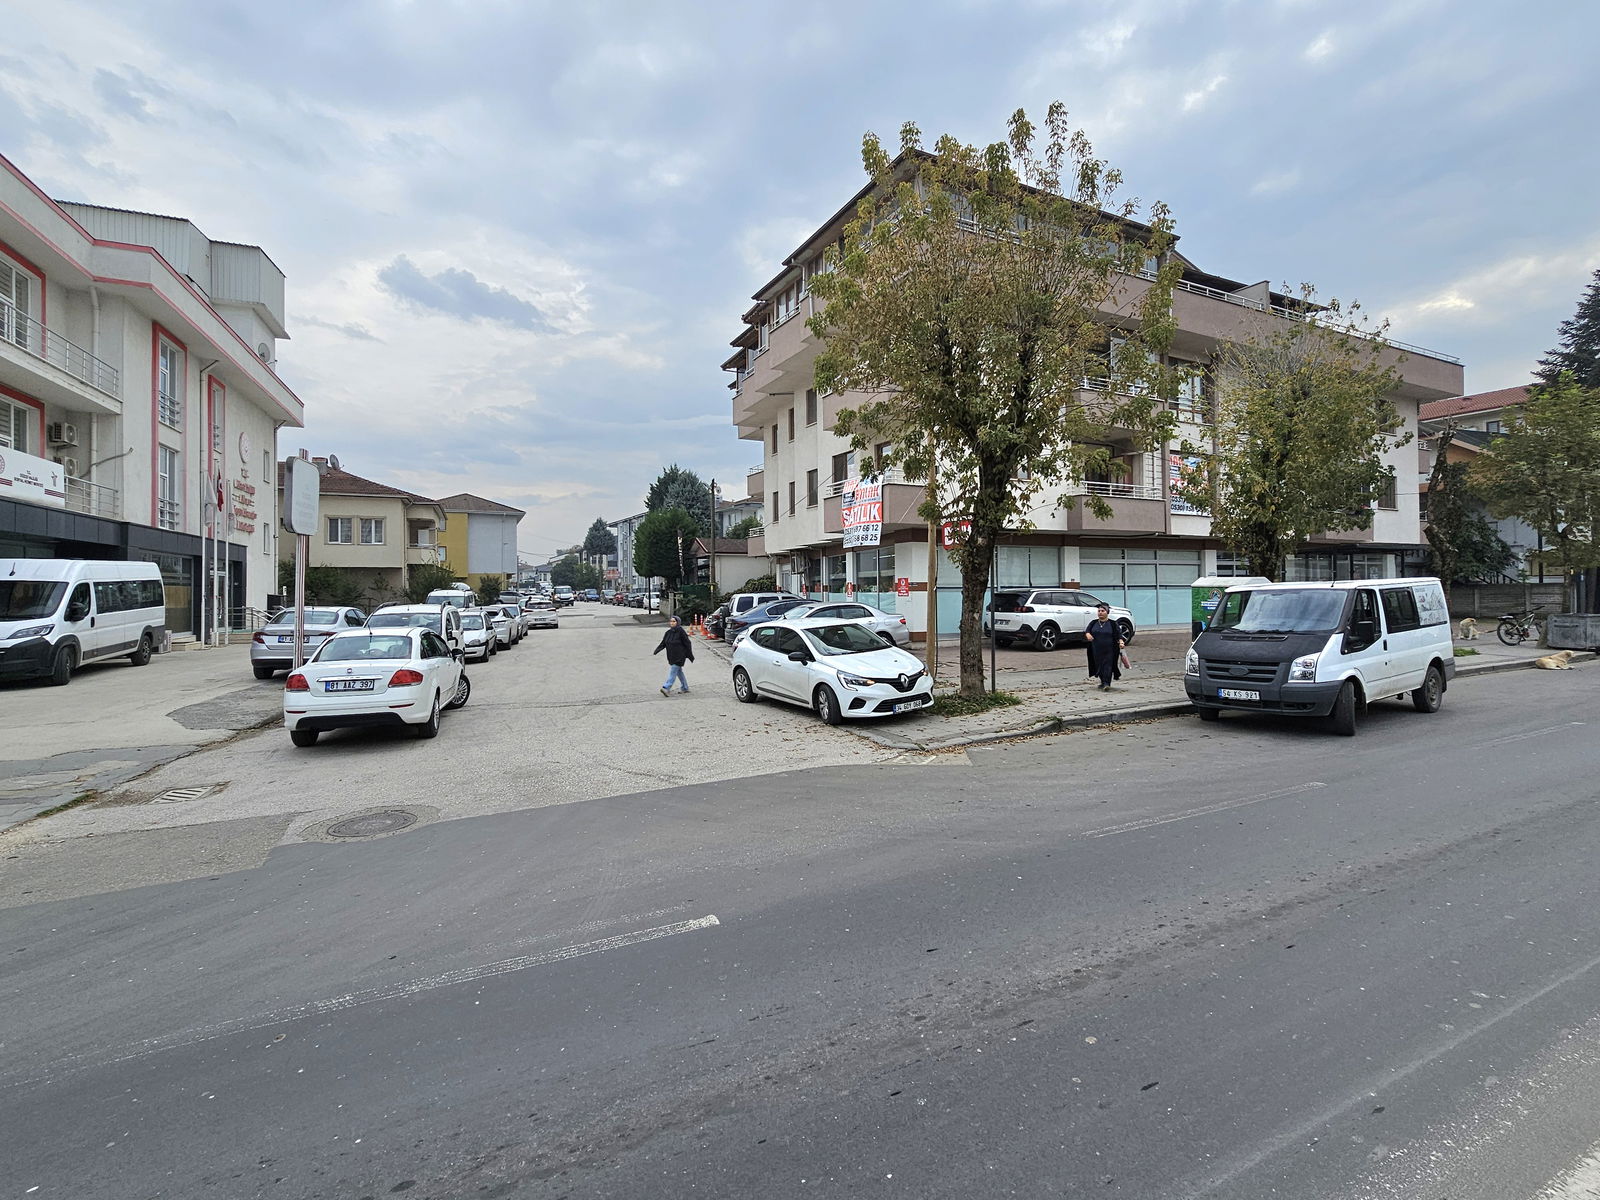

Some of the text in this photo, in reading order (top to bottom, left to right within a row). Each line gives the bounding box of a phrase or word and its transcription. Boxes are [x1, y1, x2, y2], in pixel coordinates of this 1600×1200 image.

[842, 503, 881, 527] SATILIK
[343, 681, 356, 689] AAZ
[360, 680, 372, 688] 397
